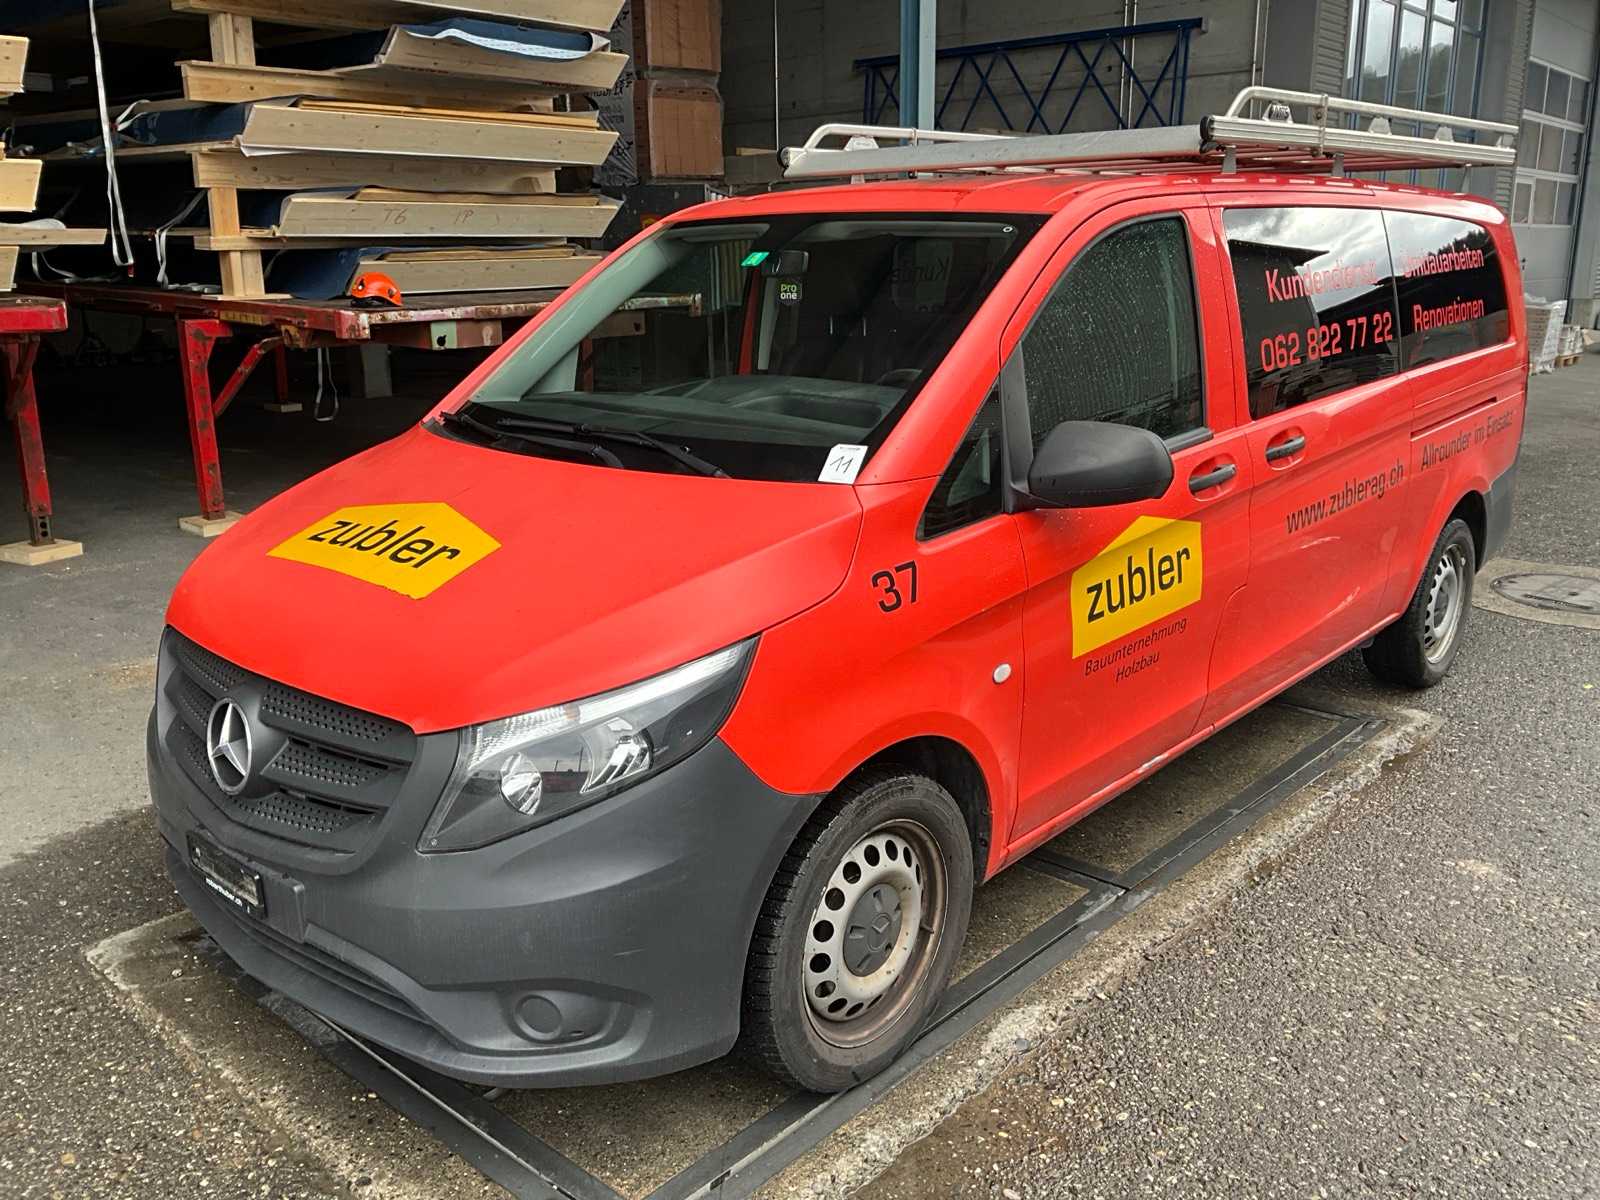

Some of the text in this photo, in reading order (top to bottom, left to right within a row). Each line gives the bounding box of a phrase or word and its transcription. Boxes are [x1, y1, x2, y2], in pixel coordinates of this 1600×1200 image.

[780, 292, 798, 300] one
[1413, 296, 1485, 333] Renovationen
[1260, 311, 1394, 373] 062 822 77 22
[829, 455, 854, 474] 11
[1420, 430, 1472, 472] Allrounder
[1474, 424, 1485, 444] im
[1285, 458, 1405, 535] www.zublerag.ch
[306, 519, 462, 569] zubler
[871, 559, 918, 613] 37
[1086, 546, 1191, 624] zubler
[1084, 618, 1187, 677] Bauunternehmung
[1115, 651, 1160, 683] Holzbau
